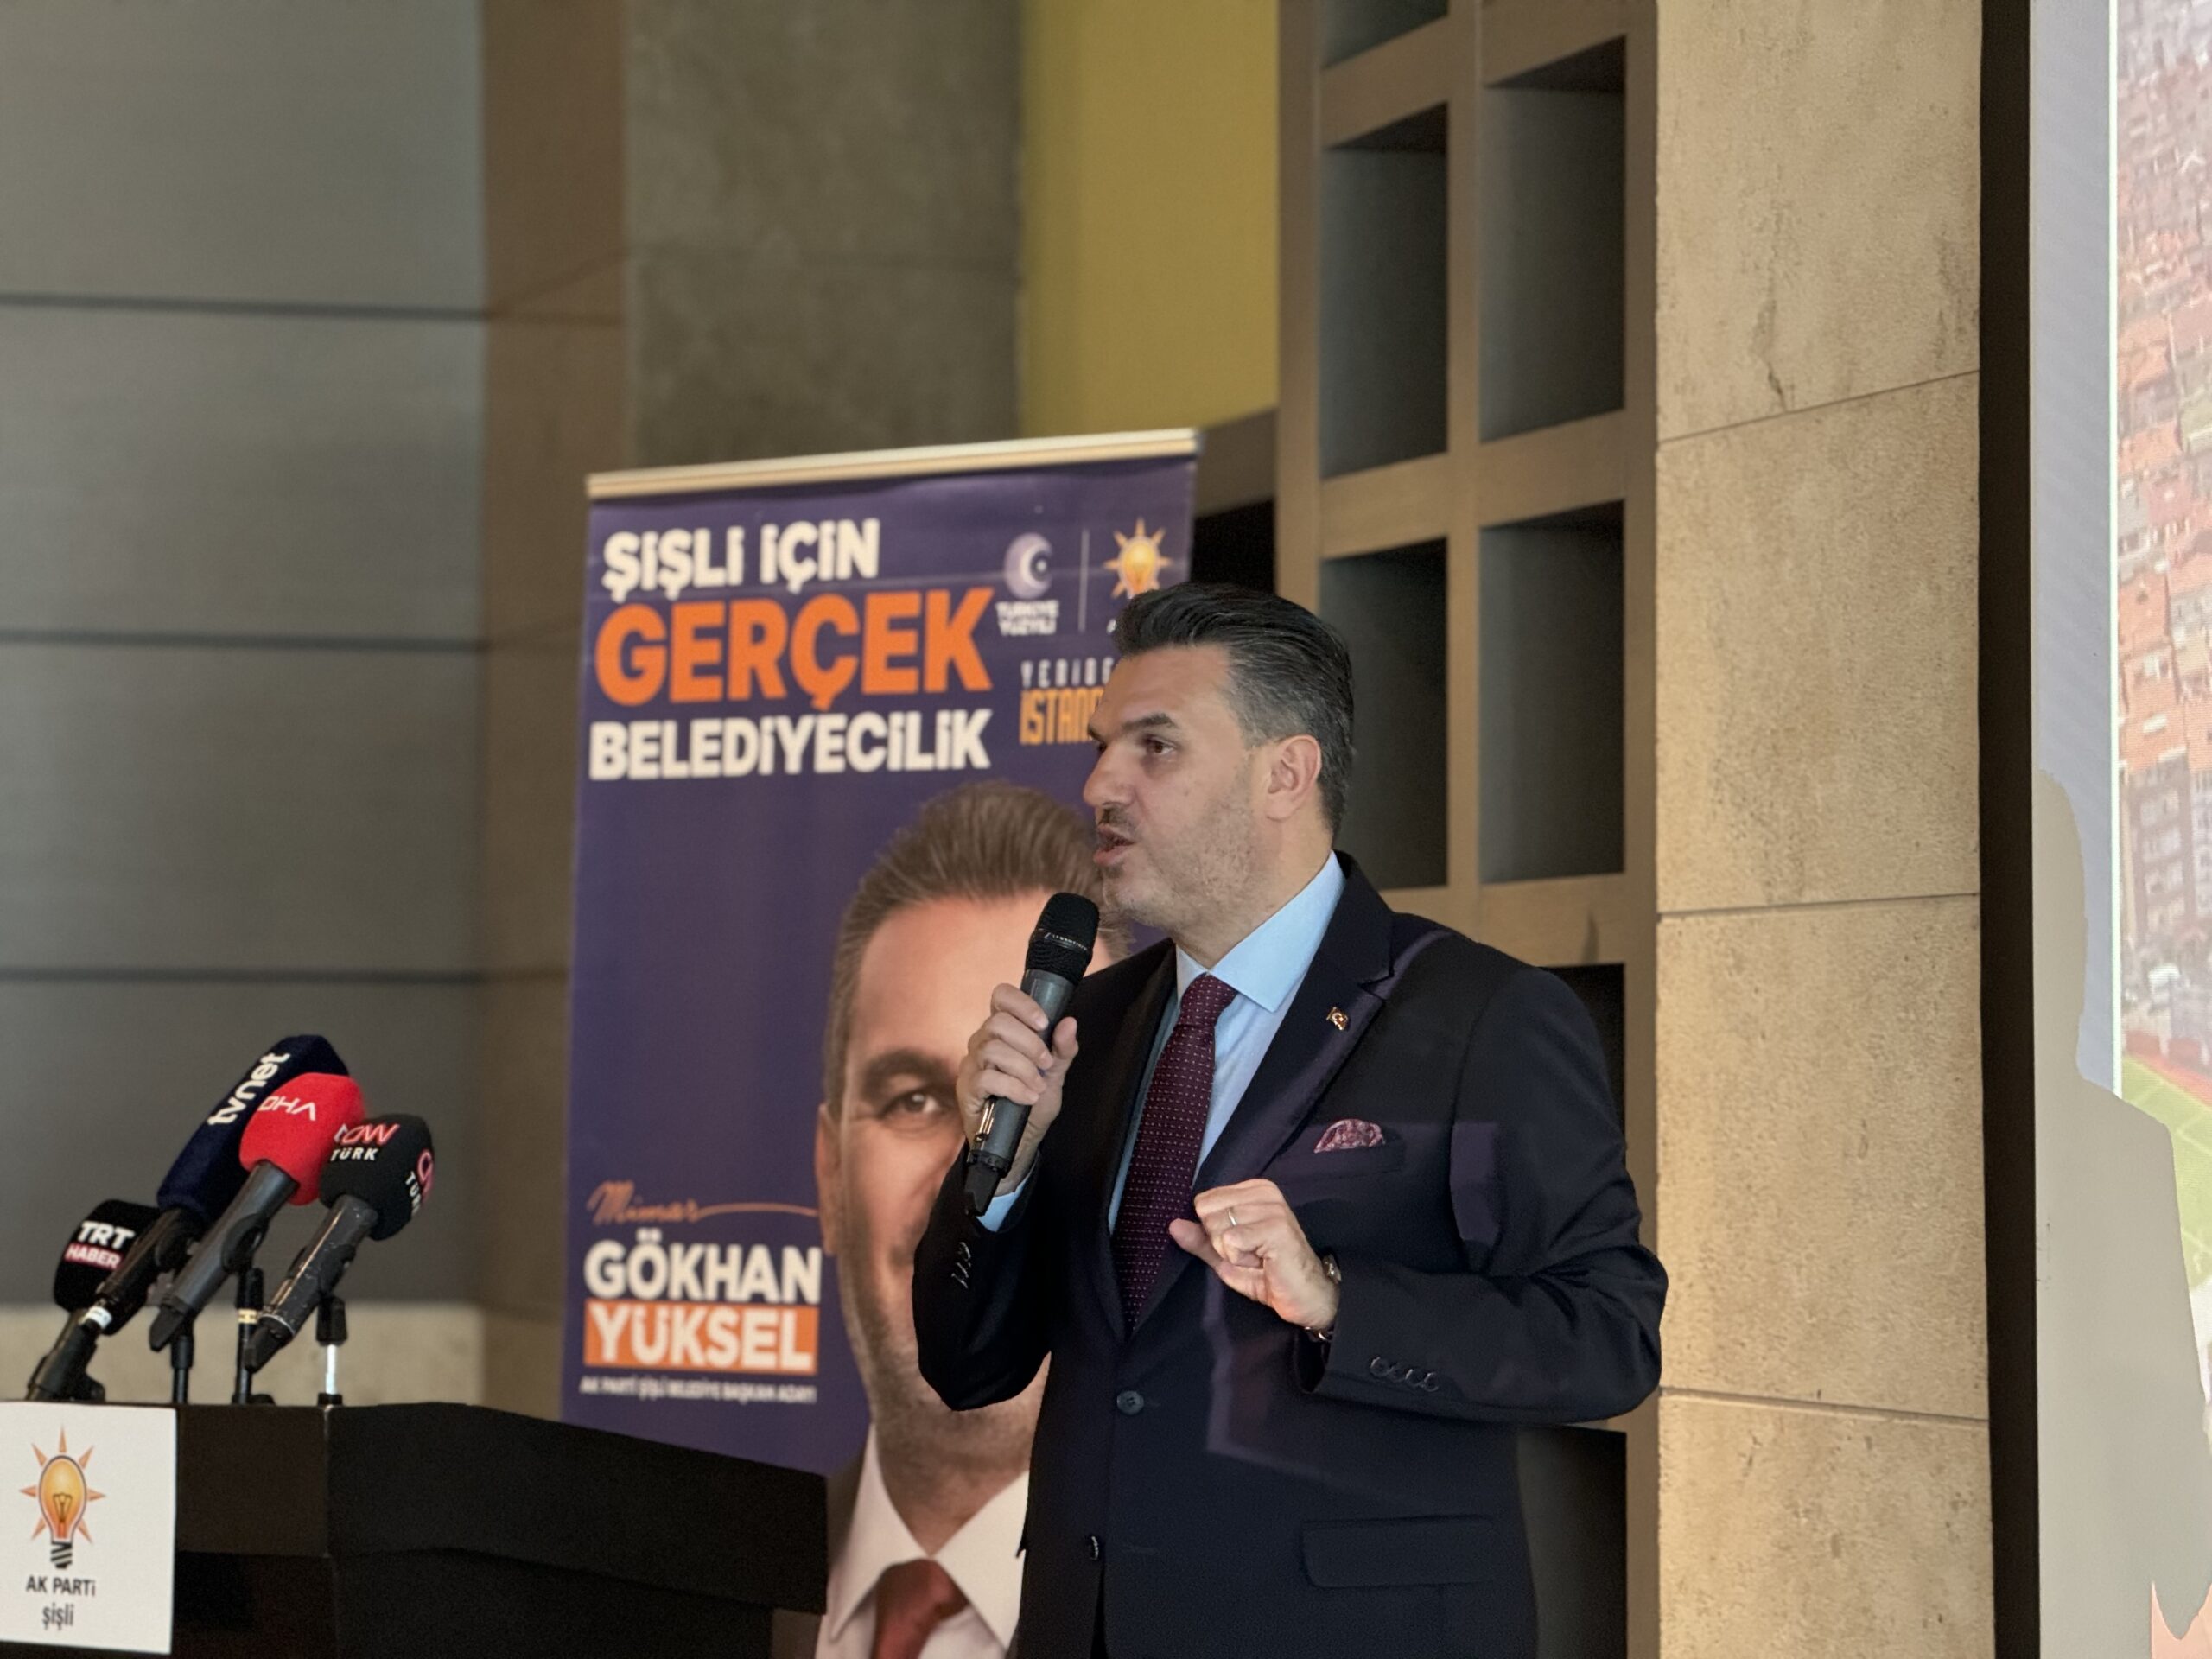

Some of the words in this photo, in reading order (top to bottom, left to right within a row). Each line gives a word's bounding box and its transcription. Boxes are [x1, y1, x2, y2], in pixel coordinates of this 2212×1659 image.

[760, 518, 880, 594] İÇİN
[594, 588, 995, 711] GERÇEK
[588, 709, 993, 780] BELEDİYECİLİK
[207, 1052, 291, 1125] tvnet
[330, 1146, 378, 1161] TÜRK
[64, 1243, 121, 1269] HABER
[77, 1220, 136, 1249] TRT
[584, 1227, 821, 1304] GÖKHAN
[588, 1304, 815, 1371] YÜKSEL
[26, 1574, 48, 1593] AK
